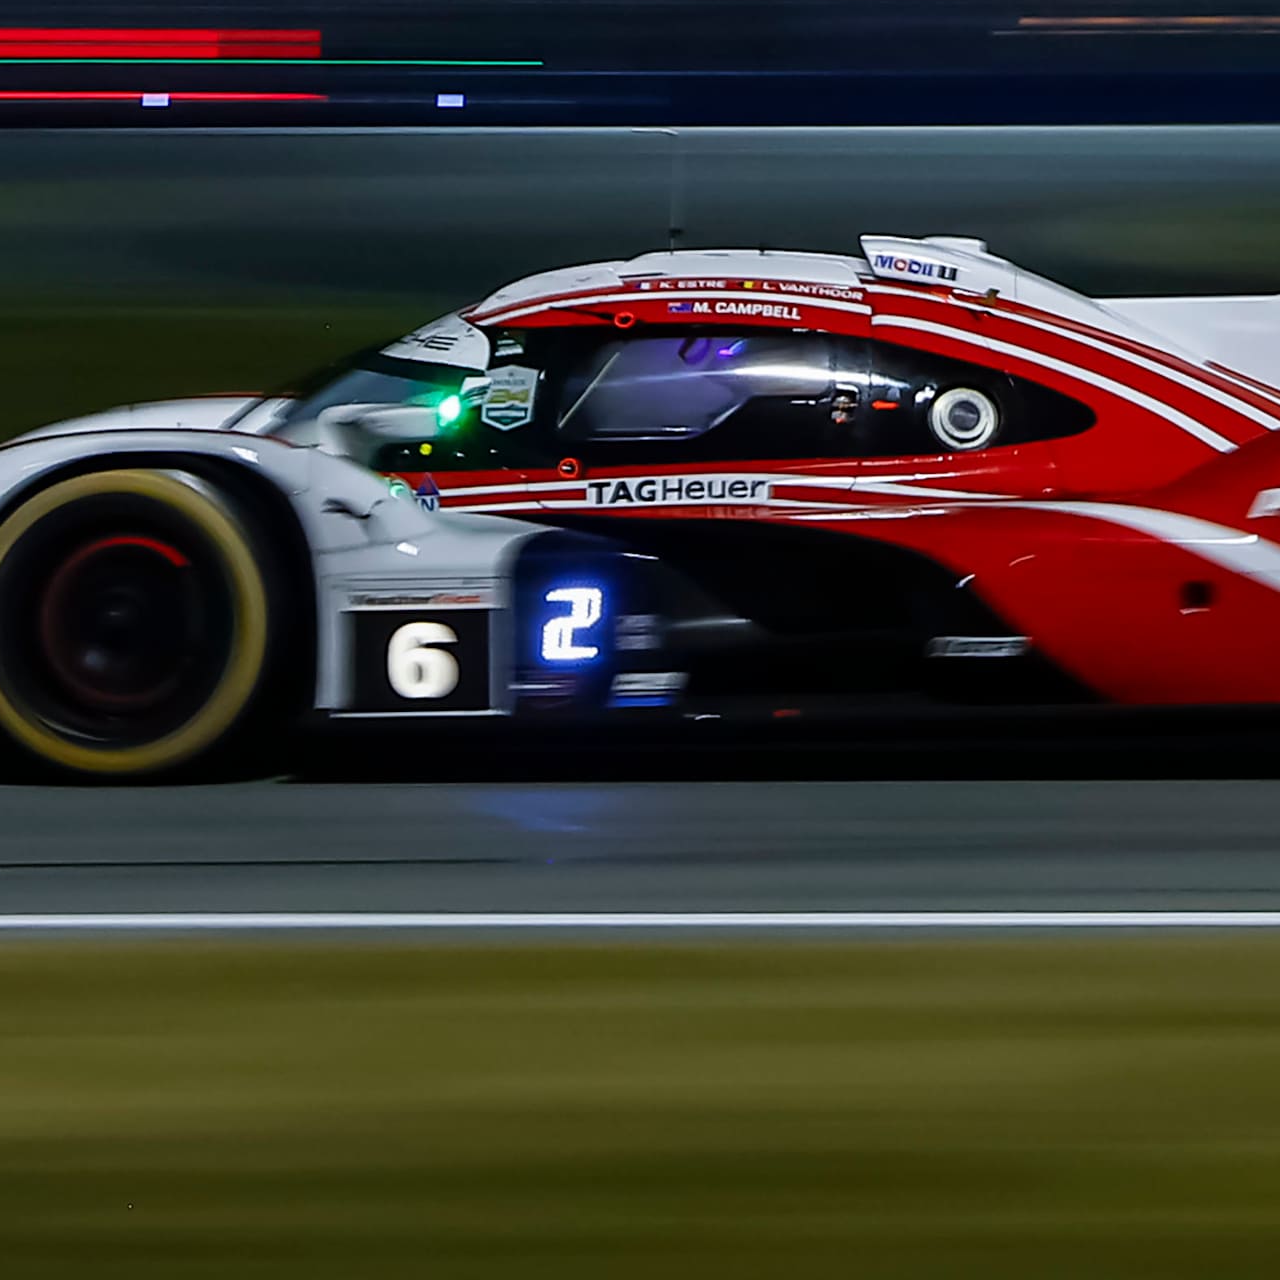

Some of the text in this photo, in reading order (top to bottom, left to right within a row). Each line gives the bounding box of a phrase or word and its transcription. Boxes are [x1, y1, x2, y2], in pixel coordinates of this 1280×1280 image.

[874, 255, 933, 277] Mobil
[677, 280, 727, 289] ESTRE
[778, 283, 863, 301] VANTHOOR
[693, 300, 801, 321] M. CAMPBELL
[542, 588, 602, 660] 2
[387, 621, 460, 698] 6
